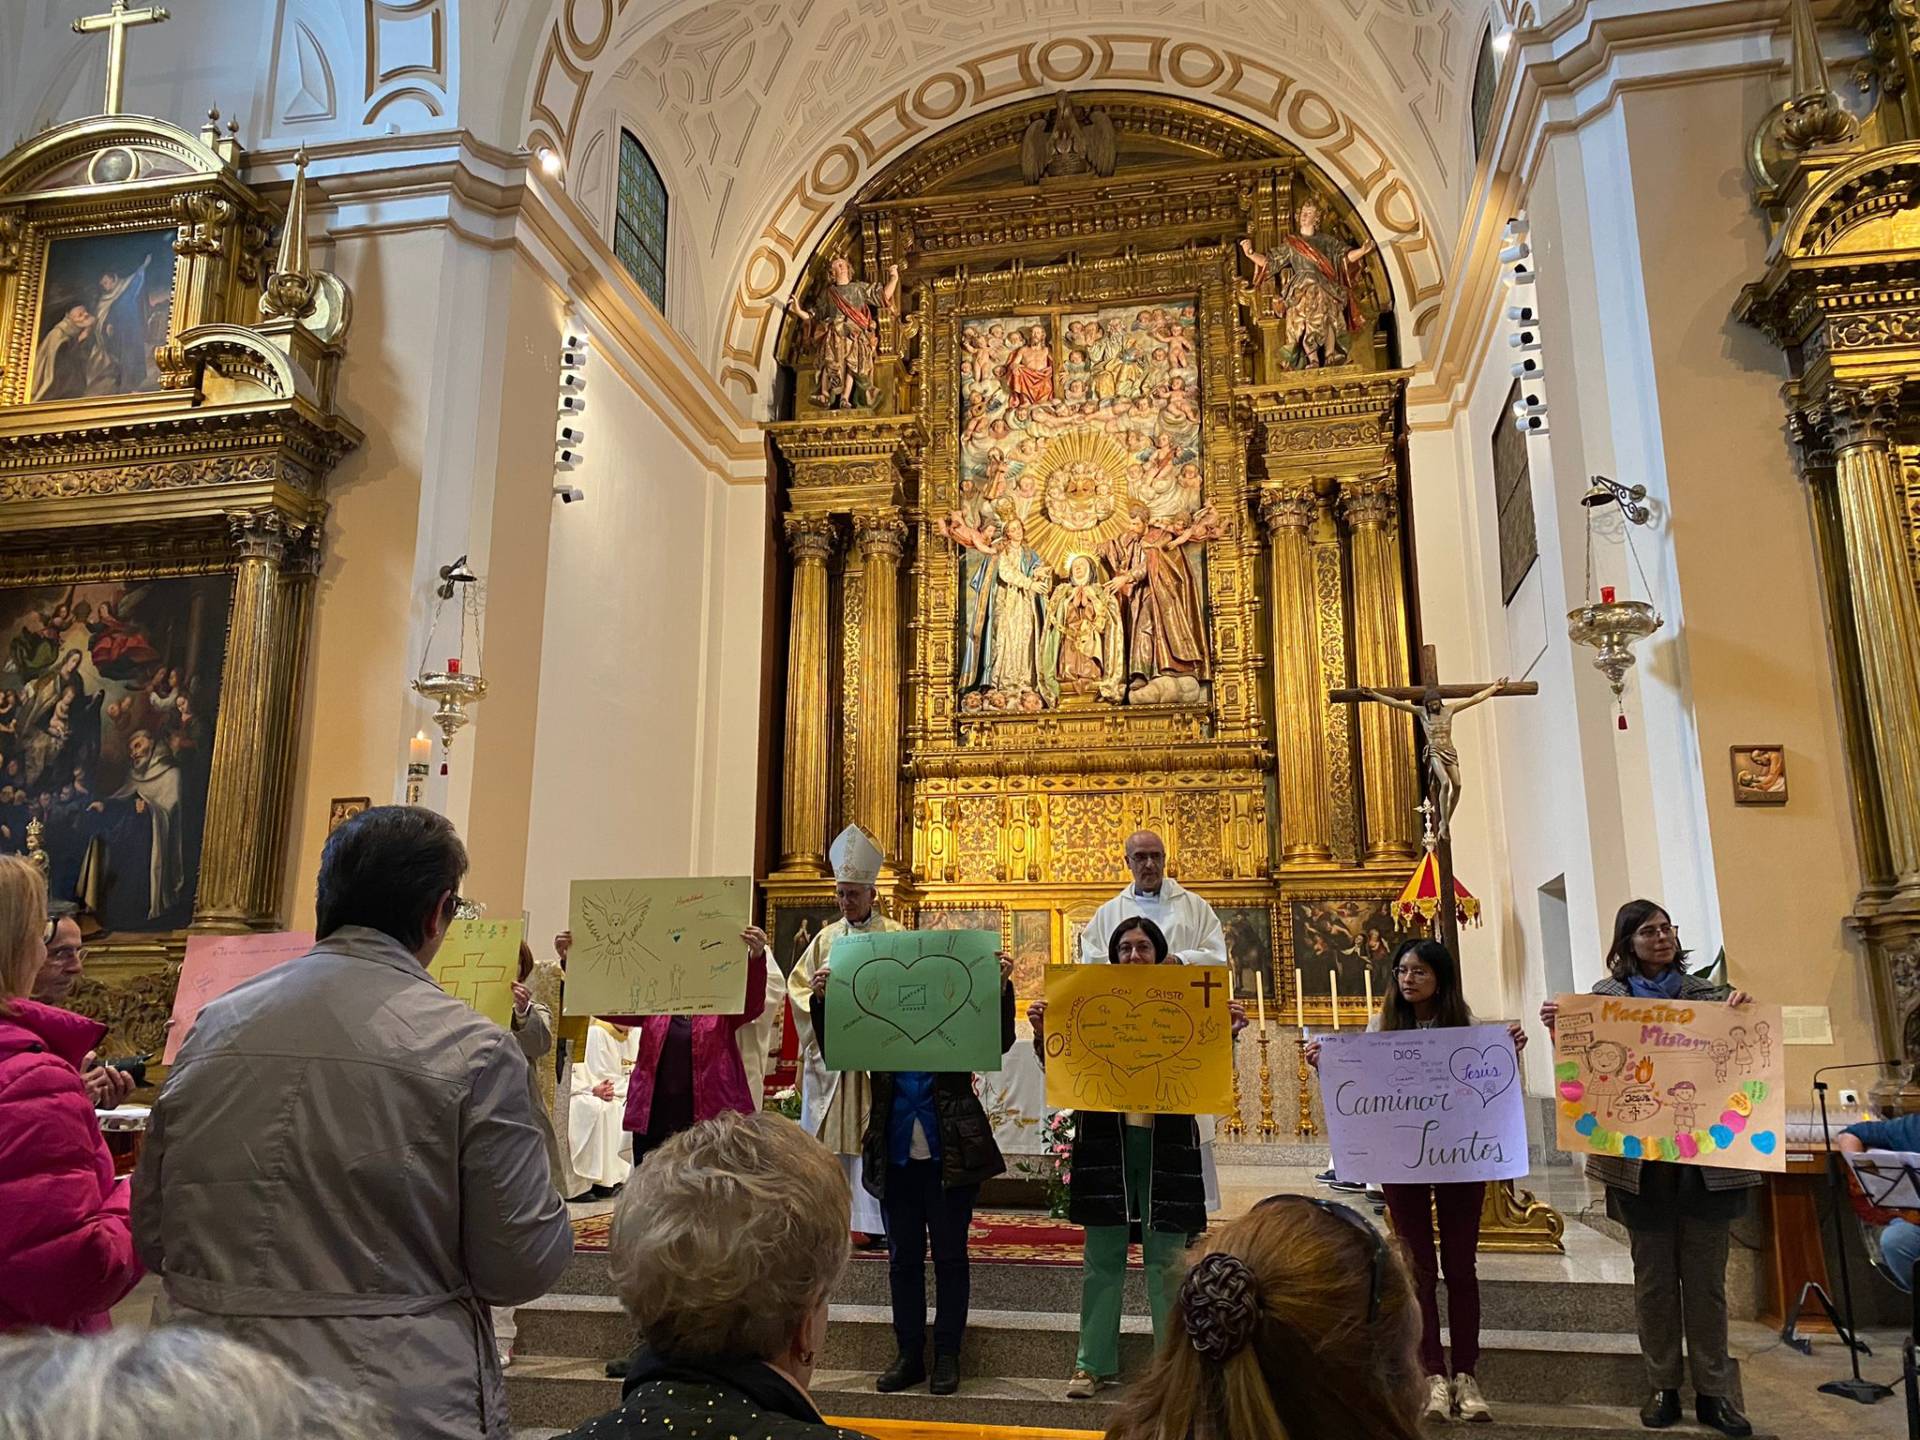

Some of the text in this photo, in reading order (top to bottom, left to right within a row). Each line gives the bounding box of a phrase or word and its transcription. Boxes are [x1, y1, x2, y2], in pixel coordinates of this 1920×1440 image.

[1111, 987, 1184, 1000] CON CRISTO
[1064, 995, 1085, 1057] ENCUENTRO
[1393, 1049, 1422, 1061] DIOS
[1336, 1080, 1454, 1116] Caminar
[1394, 1119, 1513, 1169] Juntos
